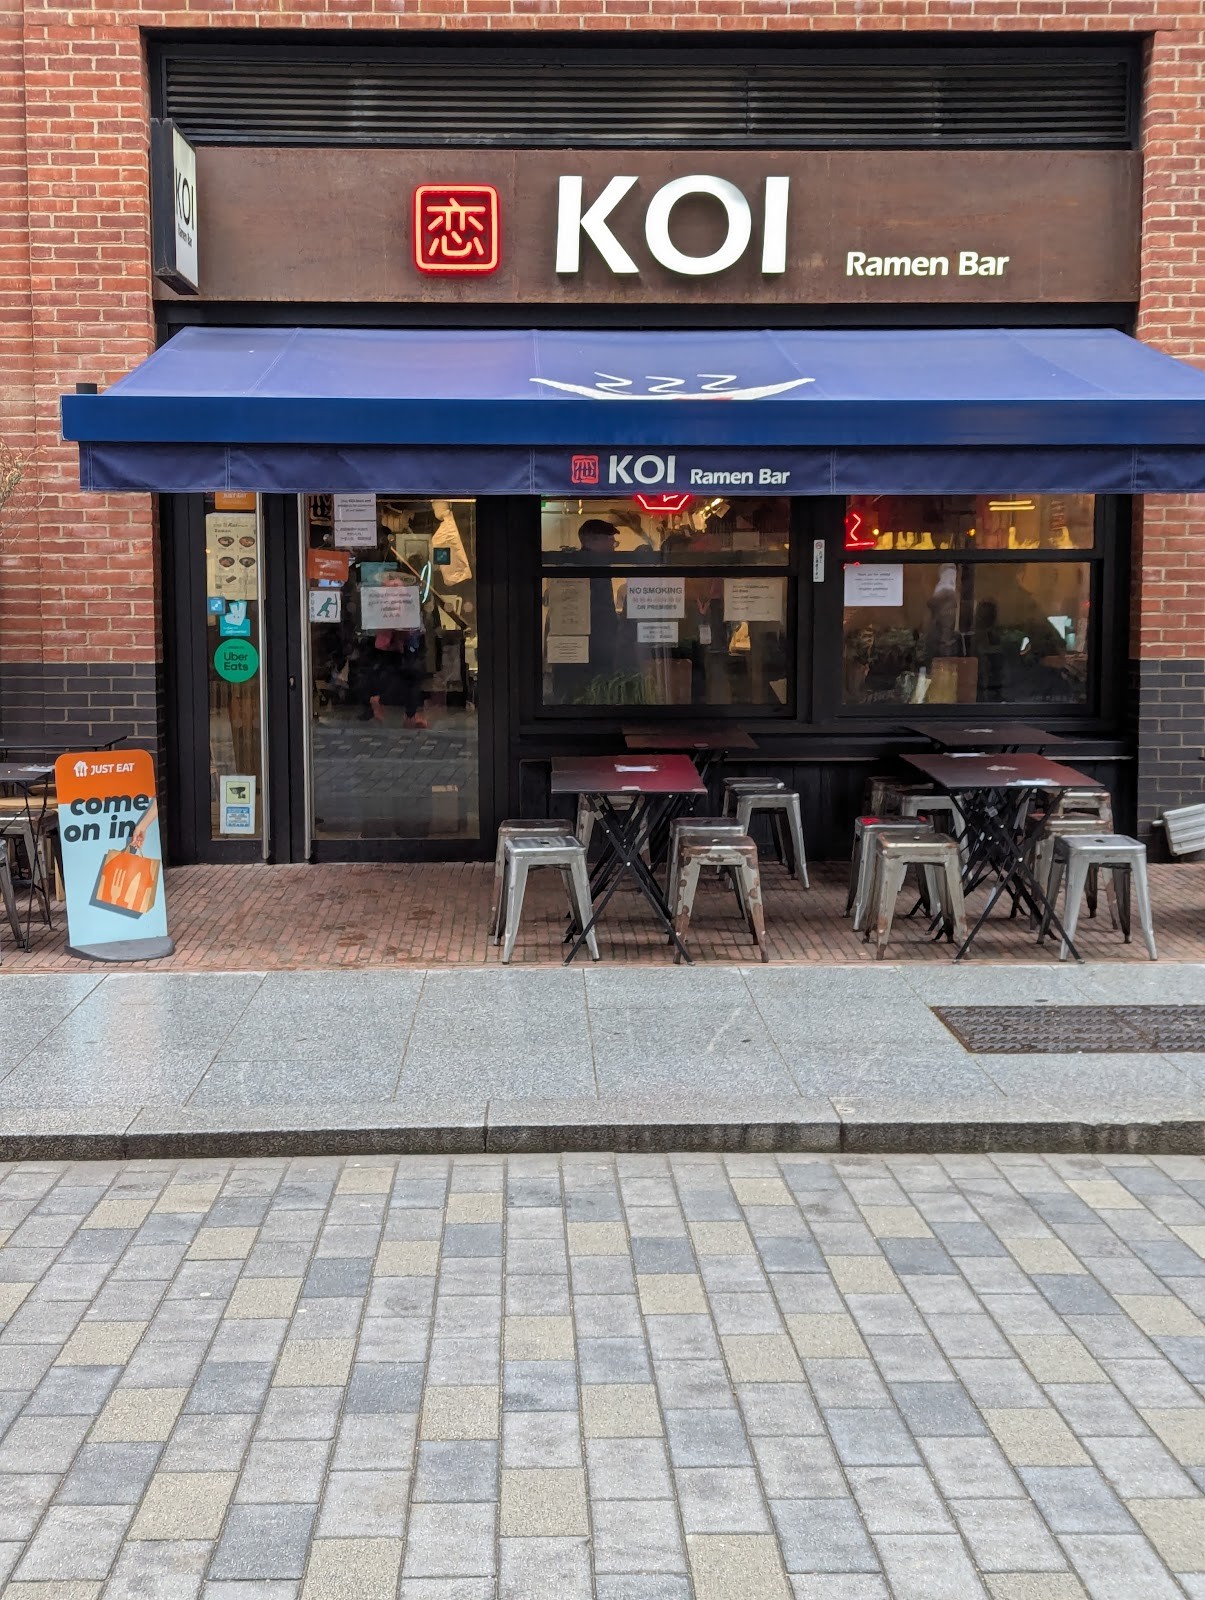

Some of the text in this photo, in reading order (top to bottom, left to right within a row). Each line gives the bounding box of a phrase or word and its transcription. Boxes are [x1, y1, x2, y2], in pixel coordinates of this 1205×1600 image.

[175, 168, 194, 230] KOI
[425, 196, 487, 258] 恋
[555, 174, 1010, 277] KOI Ramen Bar
[608, 455, 790, 485] KOI Ramen Bar
[629, 587, 682, 595] NO SMOKING
[223, 652, 248, 661] Uber
[223, 661, 249, 671] Eats
[90, 762, 135, 776] JUST EAT
[70, 793, 150, 816] come
[63, 814, 138, 843] on in
